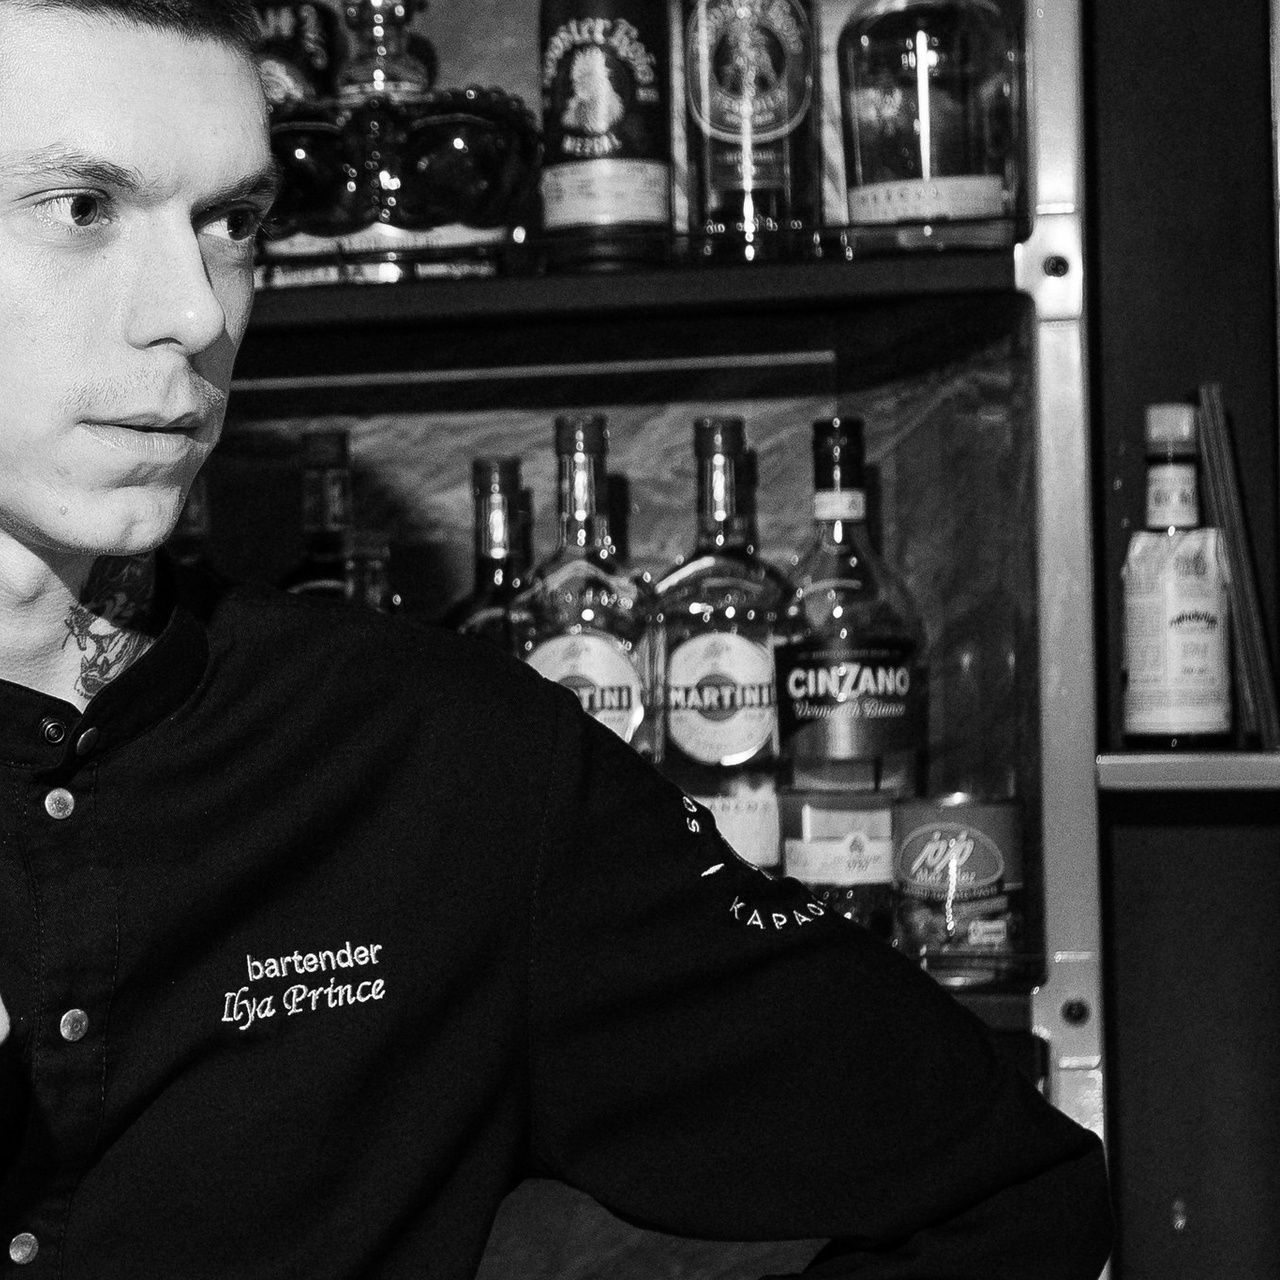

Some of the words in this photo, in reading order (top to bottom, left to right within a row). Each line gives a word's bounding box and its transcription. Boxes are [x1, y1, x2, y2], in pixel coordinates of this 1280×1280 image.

[579, 684, 633, 710] TINI
[668, 683, 773, 711] MARTINI
[787, 662, 911, 701] CINZANO
[729, 895, 827, 930] КАРАО
[246, 941, 383, 982] bartender
[221, 985, 276, 1031] Ilya
[282, 976, 387, 1017] Prince
